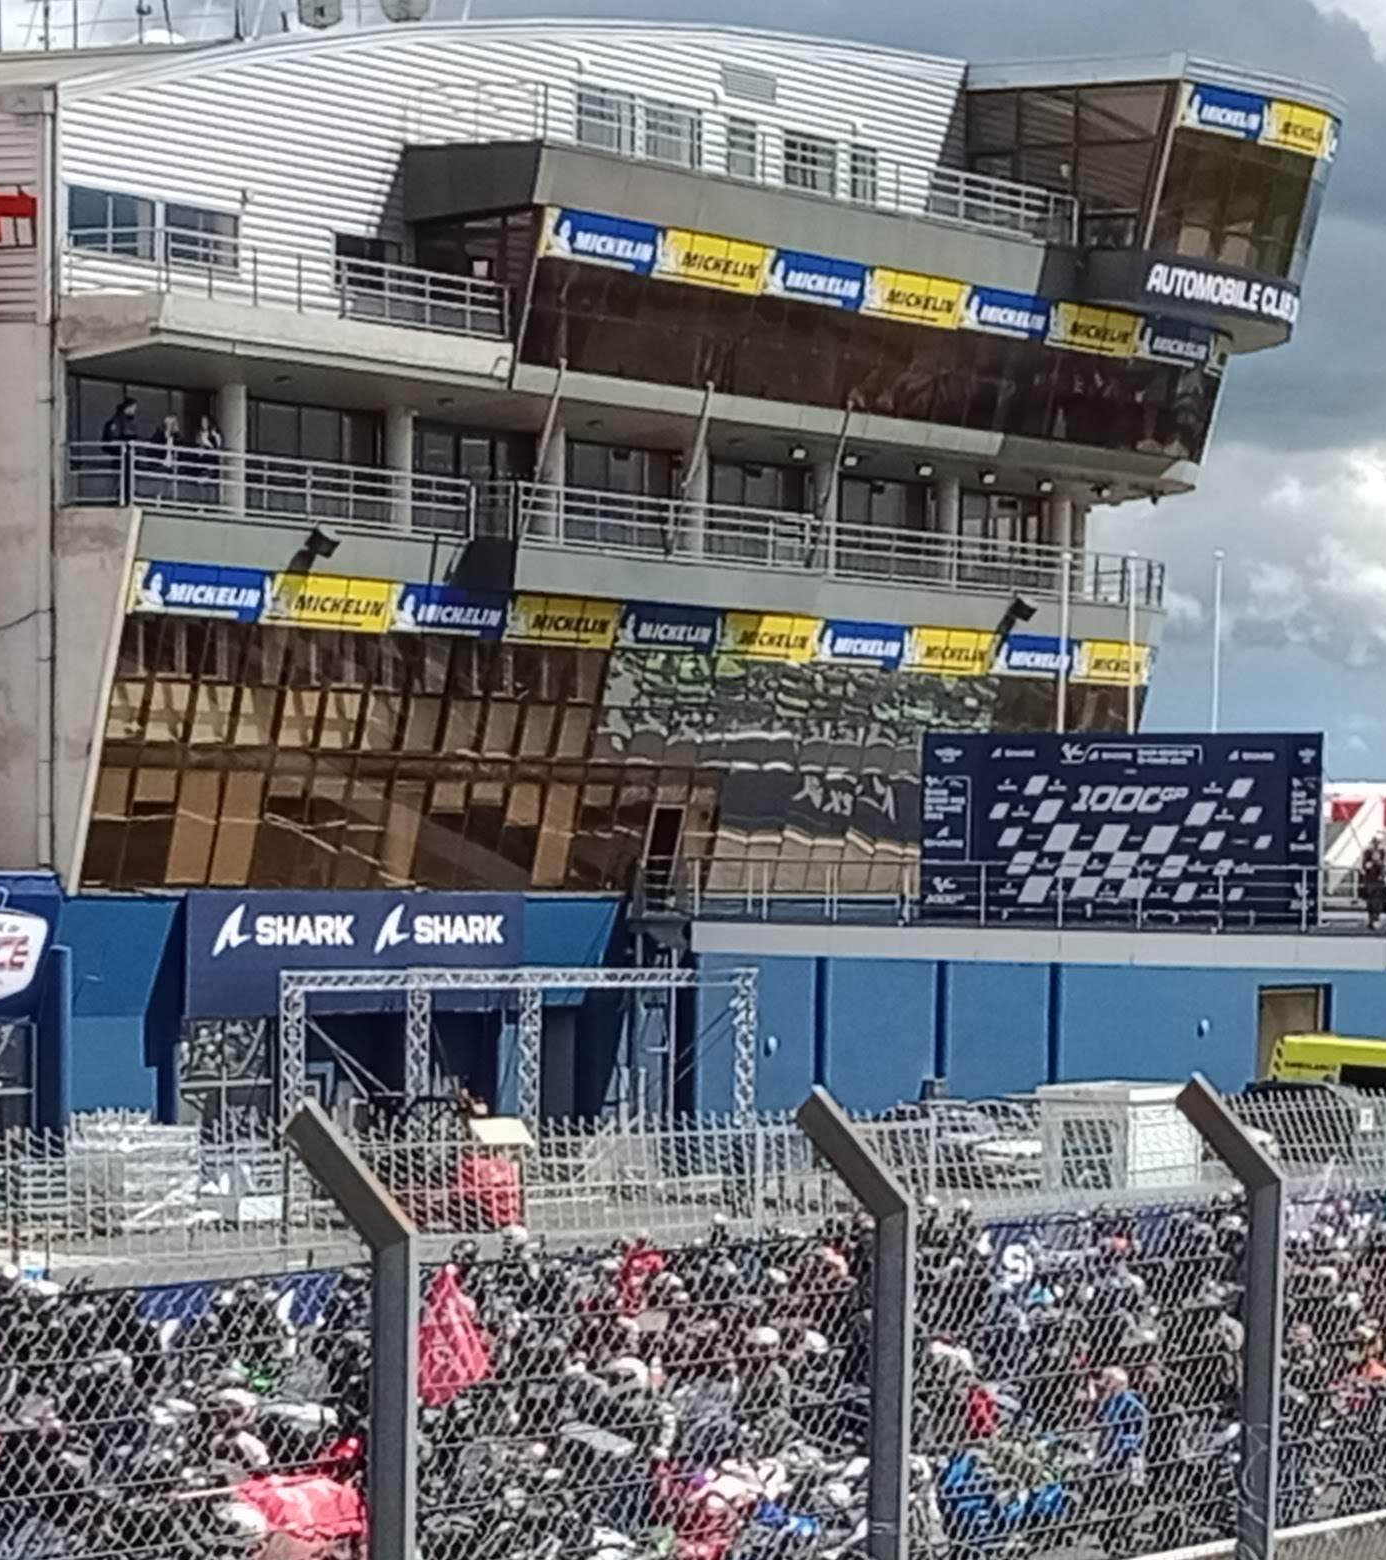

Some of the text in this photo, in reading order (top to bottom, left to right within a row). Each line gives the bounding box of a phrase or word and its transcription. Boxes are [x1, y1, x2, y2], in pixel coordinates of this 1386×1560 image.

[573, 229, 654, 261] MICHELIN
[680, 251, 758, 280] MICHELIN
[785, 269, 861, 298] MICHELIN
[886, 288, 955, 314] MICHELIN
[980, 304, 1046, 331] MICHELIN
[1146, 263, 1260, 312] AUTOMOBILE
[166, 580, 261, 609] MICHELIN
[294, 592, 386, 620] MICHELIN
[417, 601, 502, 629] MICHELIN
[531, 612, 610, 636] MICHELIN
[638, 620, 712, 645] MICHELIN
[740, 628, 810, 652] MICHELIN
[834, 634, 901, 659] MICHELIN
[924, 644, 990, 664] MICHELIN
[254, 913, 505, 946] SHARK SHARK
